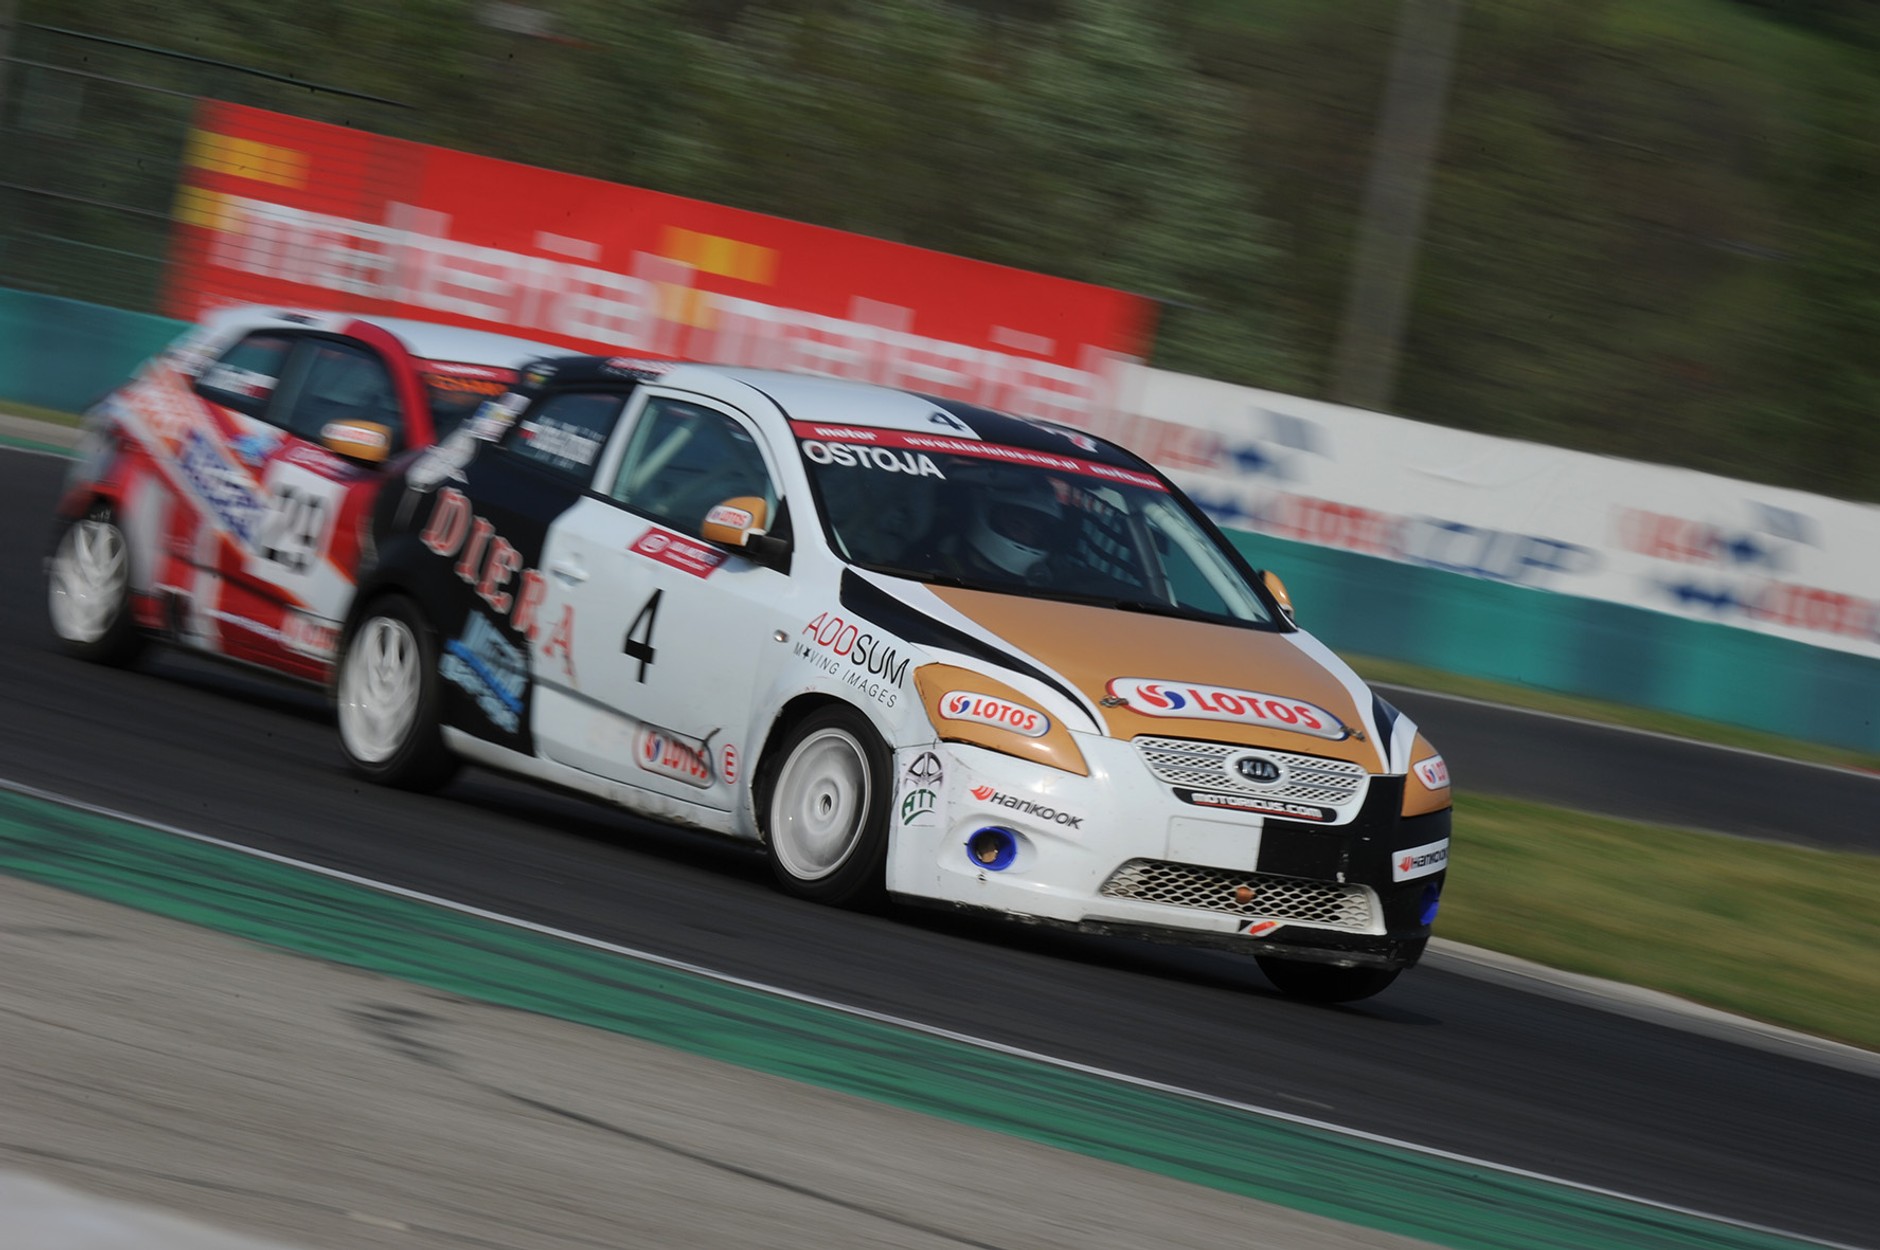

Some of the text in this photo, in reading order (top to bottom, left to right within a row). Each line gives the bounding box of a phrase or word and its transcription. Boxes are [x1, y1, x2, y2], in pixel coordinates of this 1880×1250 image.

[814, 427, 877, 441] motor
[928, 411, 966, 432] 4
[802, 440, 947, 480] OSTOJA
[624, 588, 664, 684] 4
[842, 668, 897, 708] IMAGES
[972, 698, 1038, 731] LOTOS
[1188, 688, 1322, 730] LOTOS
[725, 750, 735, 777] E
[1242, 760, 1276, 778] KIA
